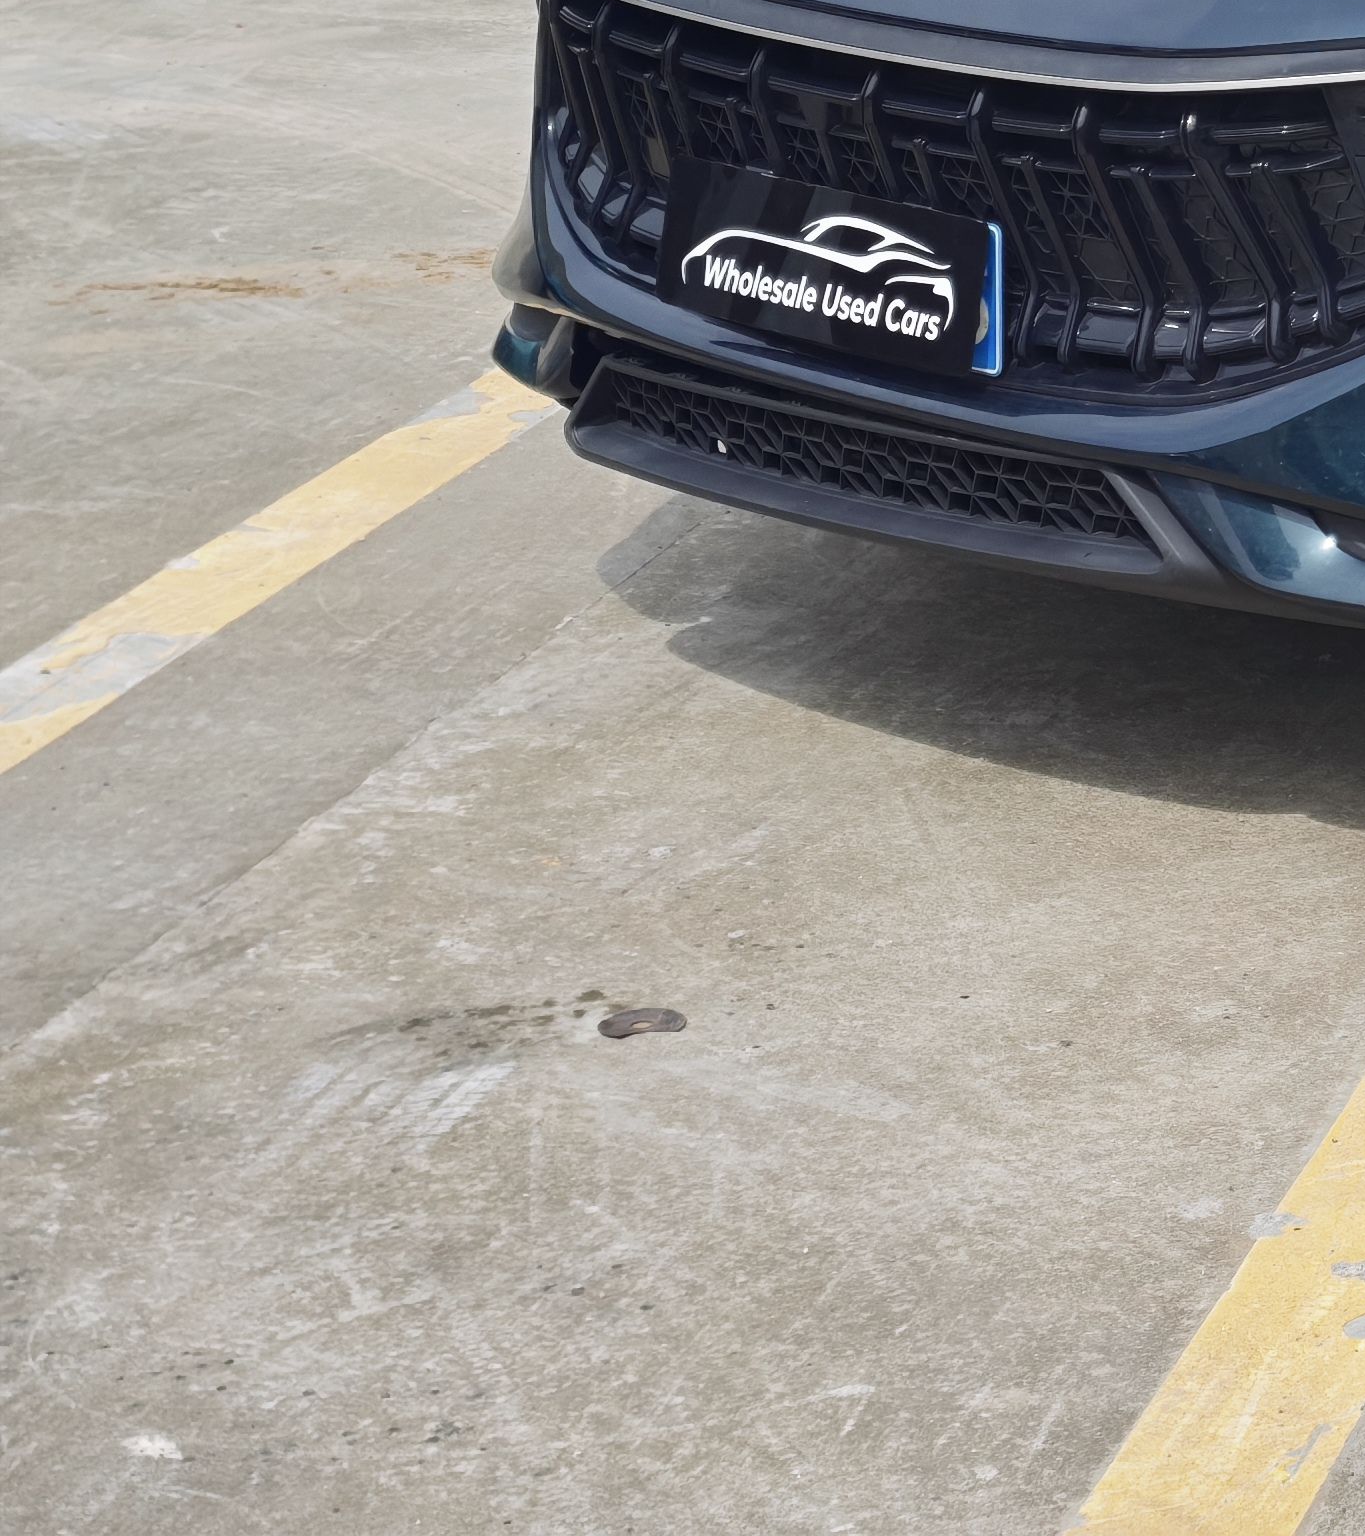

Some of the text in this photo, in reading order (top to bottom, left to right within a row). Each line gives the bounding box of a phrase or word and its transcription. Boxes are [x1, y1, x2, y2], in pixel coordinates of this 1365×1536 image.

[703, 254, 941, 342] Wholesale Used Cars
